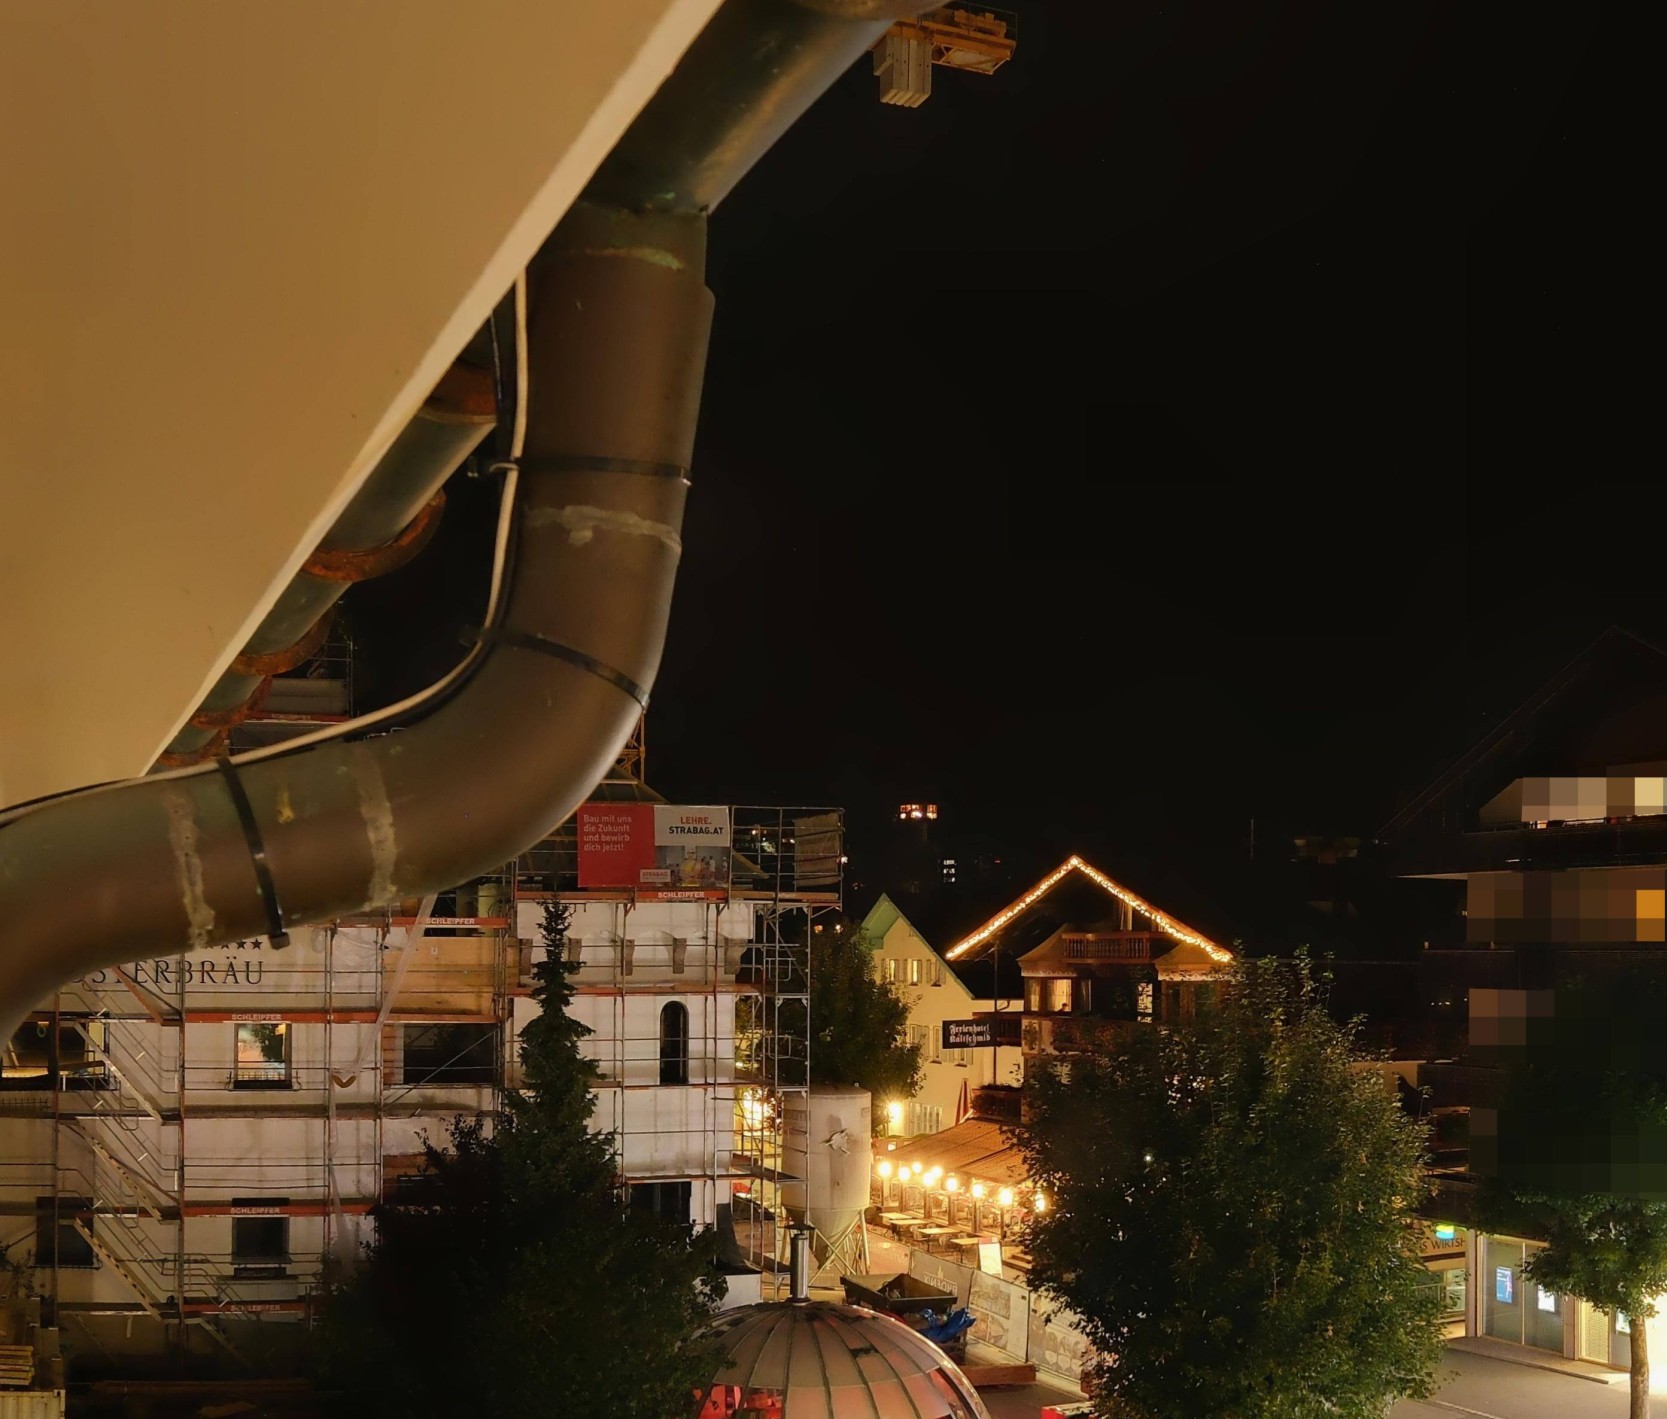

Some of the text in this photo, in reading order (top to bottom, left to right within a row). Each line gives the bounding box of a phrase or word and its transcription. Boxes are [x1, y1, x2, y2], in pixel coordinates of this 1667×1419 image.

[583, 814, 599, 823] Bau
[601, 814, 615, 823] mit
[680, 816, 712, 825] LEHRE.
[583, 824, 630, 832] die Zukunft
[668, 826, 724, 835] STRABAG.AT
[583, 834, 630, 842] und bewirb
[583, 843, 624, 853] dich jetzt!
[657, 891, 705, 899] SCHLEIPFER
[426, 917, 475, 925] SCHLEIPFER
[231, 1013, 282, 1021] SCHLEIPFER
[230, 1206, 280, 1214] SCHLEIPFER
